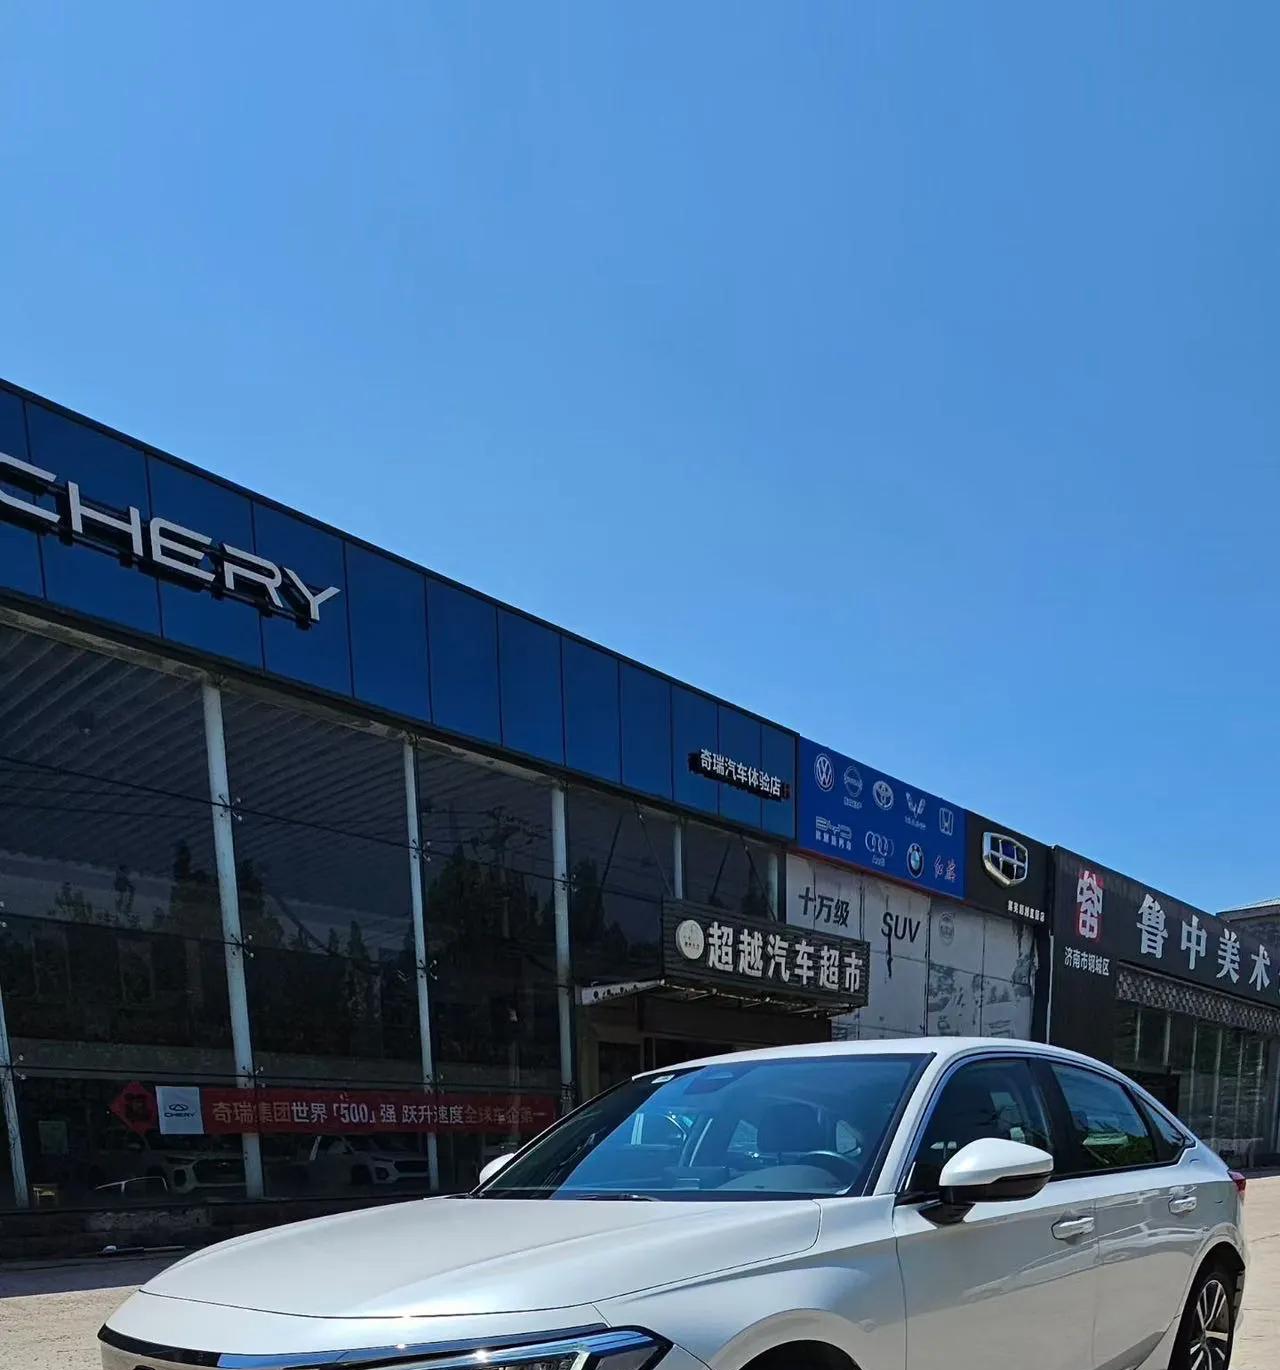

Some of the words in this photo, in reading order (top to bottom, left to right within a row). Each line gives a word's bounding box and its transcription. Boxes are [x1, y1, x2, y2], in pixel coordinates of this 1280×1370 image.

[0, 452, 340, 621] CHERY
[700, 748, 781, 797] 奇瑞汽车体验店
[798, 886, 851, 928] 十万级
[880, 911, 921, 943] SUV
[1136, 893, 1280, 996] 鲁中美术
[708, 921, 863, 993] 超越汽车超市
[1064, 946, 1110, 976] 济南市钢城区
